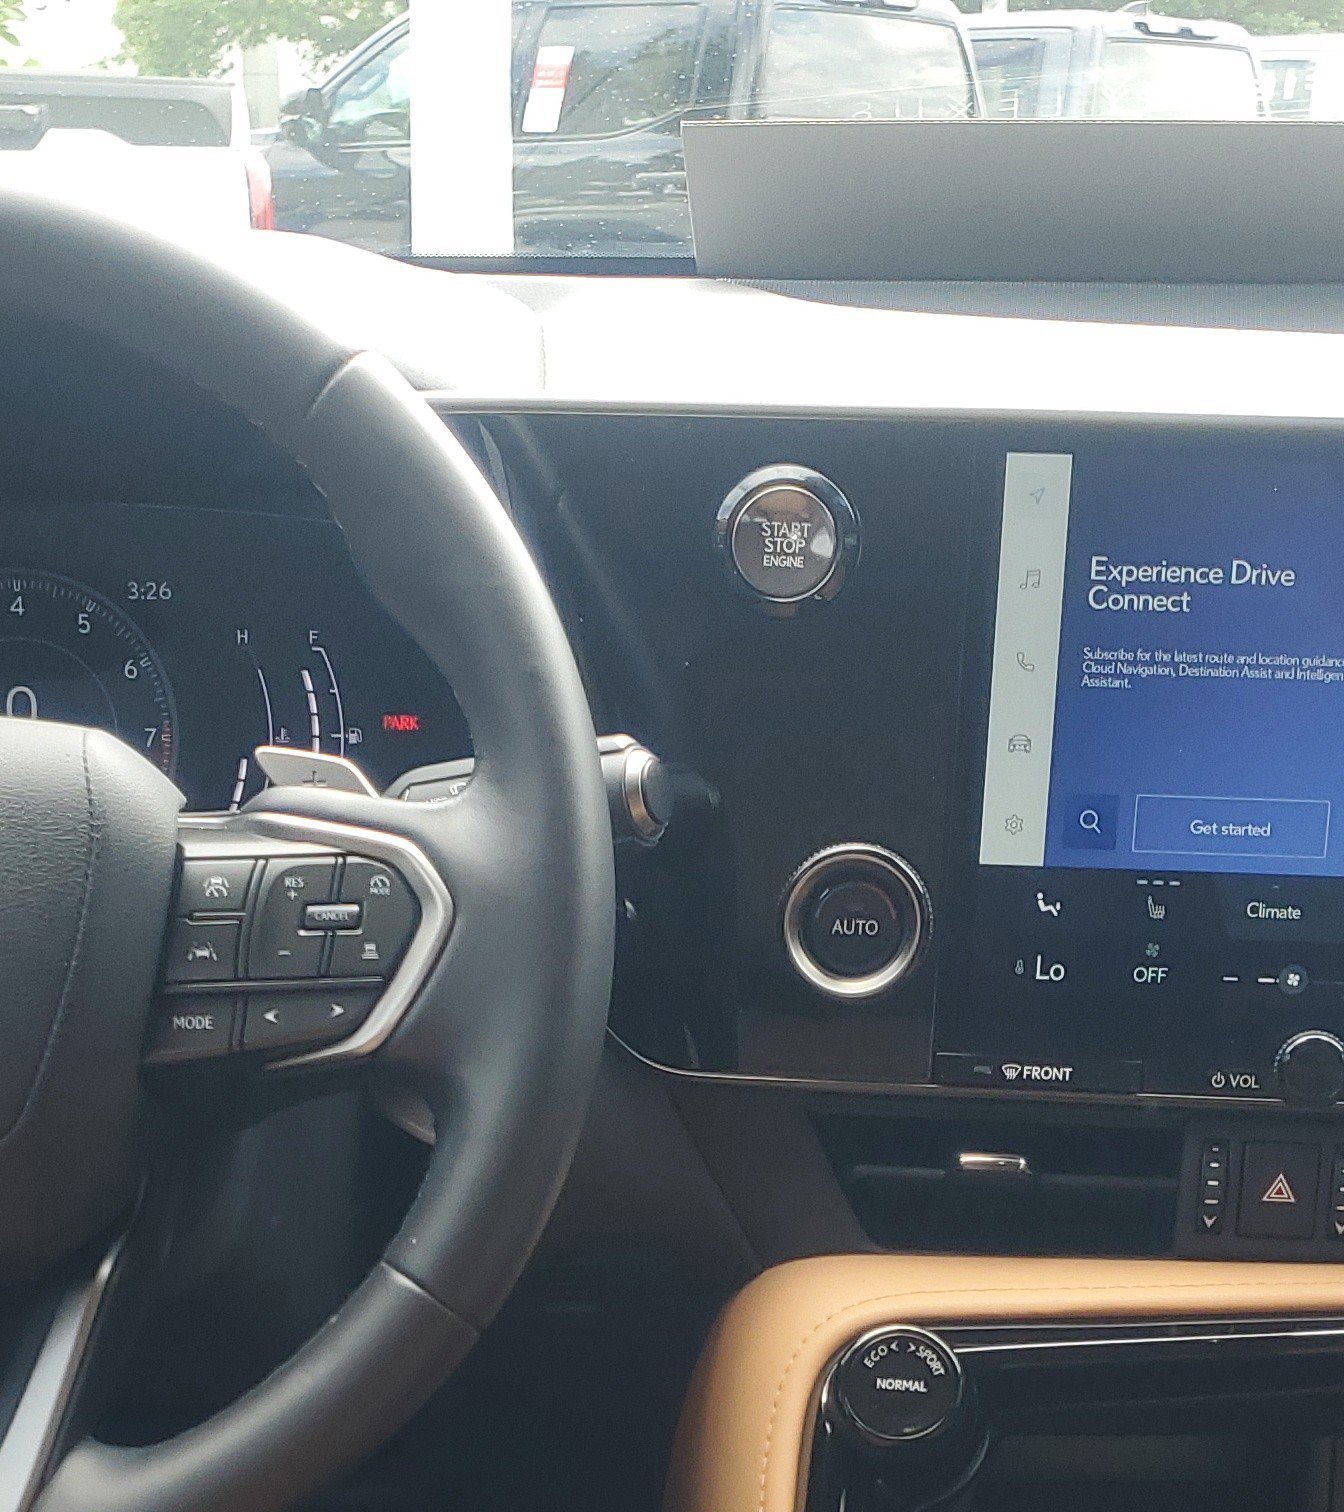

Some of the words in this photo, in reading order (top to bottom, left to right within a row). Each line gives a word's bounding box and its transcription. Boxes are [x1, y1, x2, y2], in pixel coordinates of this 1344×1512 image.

[761, 521, 812, 538] START
[764, 537, 806, 553] STOP
[763, 554, 805, 568] ENGINE
[1090, 555, 1224, 587] Experience
[1231, 558, 1296, 587] Drive
[127, 581, 172, 600] 3:26
[1088, 584, 1191, 613] Connect
[9, 596, 25, 616] 4
[78, 613, 91, 635] 5
[236, 628, 249, 645] H
[309, 629, 320, 645] F
[1083, 647, 1134, 661] Subscribe
[1137, 648, 1151, 661] for
[1155, 649, 1171, 662] the
[1174, 650, 1203, 663] latest
[1205, 652, 1235, 665] route
[1236, 652, 1257, 665] and
[1258, 653, 1300, 667] location
[124, 661, 138, 680] 6
[1082, 661, 1115, 674] Cloud
[1117, 662, 1176, 678] Navigation,
[1178, 664, 1239, 678] Destination
[1241, 666, 1272, 679] Assist
[1274, 667, 1295, 680] and
[1081, 675, 1132, 689] Assistant.
[383, 714, 420, 731] PARK
[143, 727, 158, 748] 7
[1190, 819, 1218, 836] Get
[1221, 821, 1271, 837] started
[313, 910, 350, 921] CANCEL
[1246, 901, 1302, 920] Climate
[831, 919, 879, 936] AUTO
[1034, 954, 1066, 982] Lo
[1133, 966, 1169, 984] OFF
[172, 1014, 215, 1031] MODE
[1022, 1065, 1074, 1083] FRONT
[1229, 1073, 1261, 1090] VOL
[863, 1345, 888, 1368] ECO
[916, 1345, 946, 1376] SPORT
[876, 1377, 928, 1393] NORMAL
